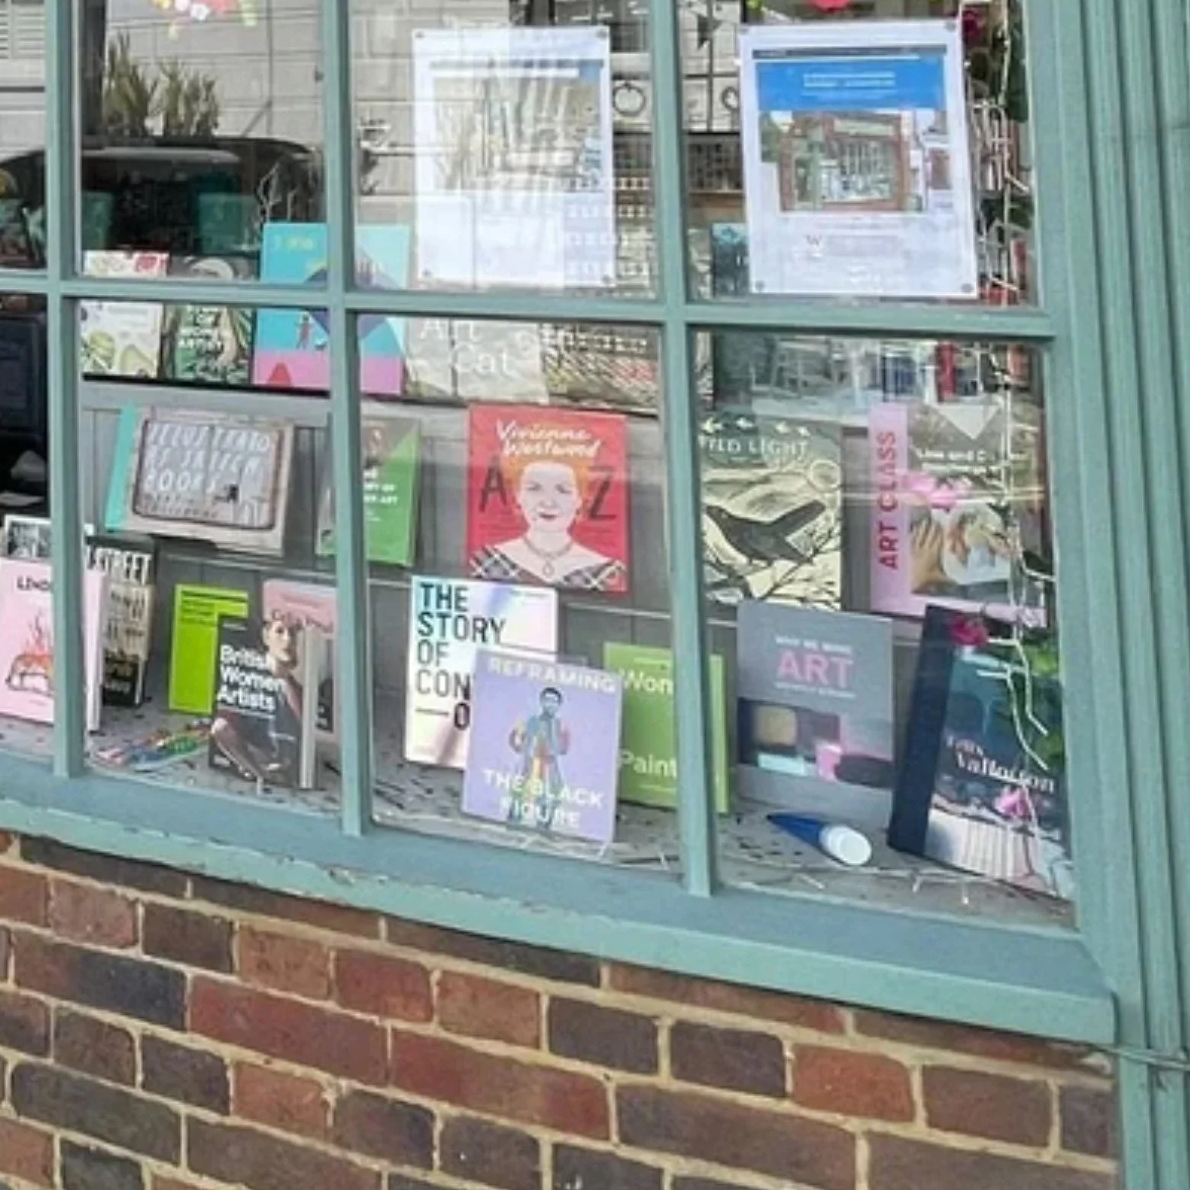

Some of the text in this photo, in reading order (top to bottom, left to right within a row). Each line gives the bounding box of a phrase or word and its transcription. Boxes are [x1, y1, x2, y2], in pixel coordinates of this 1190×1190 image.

[496, 419, 593, 441] Vivienne
[748, 436, 809, 460] LIGHT
[479, 456, 616, 521] A Z
[876, 430, 899, 571] ART CLASS
[420, 581, 469, 612] THE
[417, 611, 507, 644] STORY
[417, 638, 449, 668] OF
[777, 648, 854, 689] ART
[219, 665, 287, 692] Women
[488, 656, 616, 693] REFRAMING
[216, 684, 276, 711] Artists
[482, 768, 604, 807] THE BLACK
[500, 795, 581, 828] FIGURE
